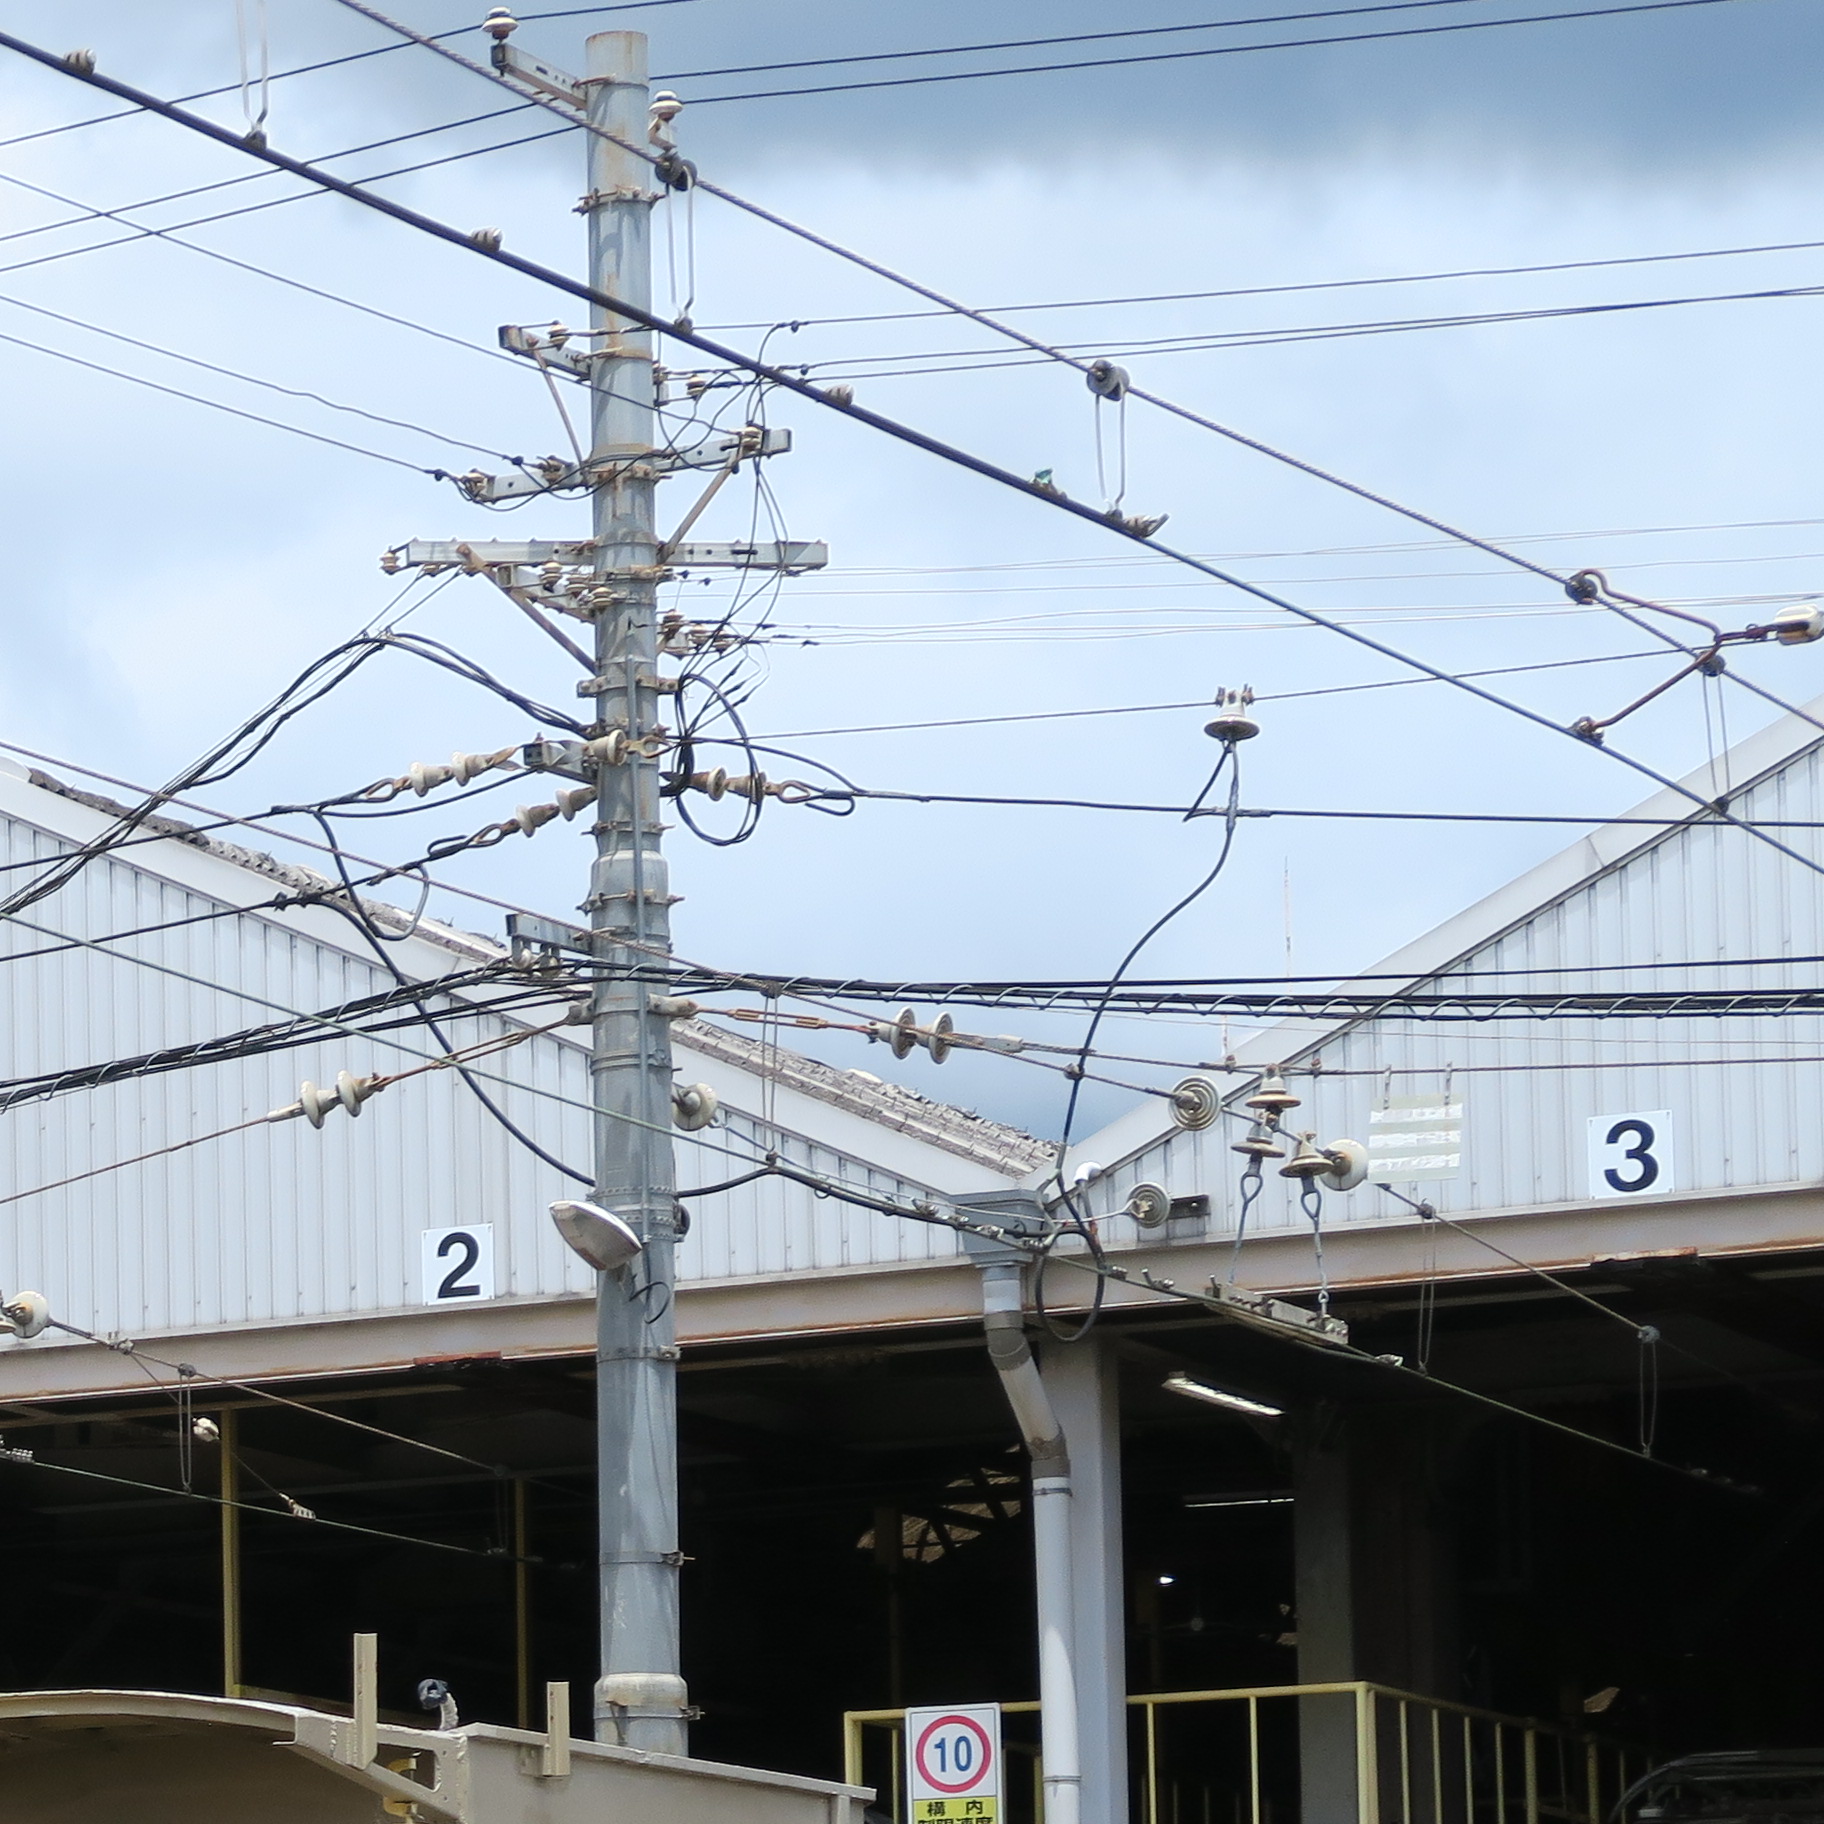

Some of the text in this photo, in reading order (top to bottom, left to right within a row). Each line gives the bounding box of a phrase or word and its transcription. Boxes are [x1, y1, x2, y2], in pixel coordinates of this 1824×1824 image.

[1604, 1119, 1659, 1192] 3
[437, 1231, 480, 1299] 2
[933, 1735, 972, 1773] 10
